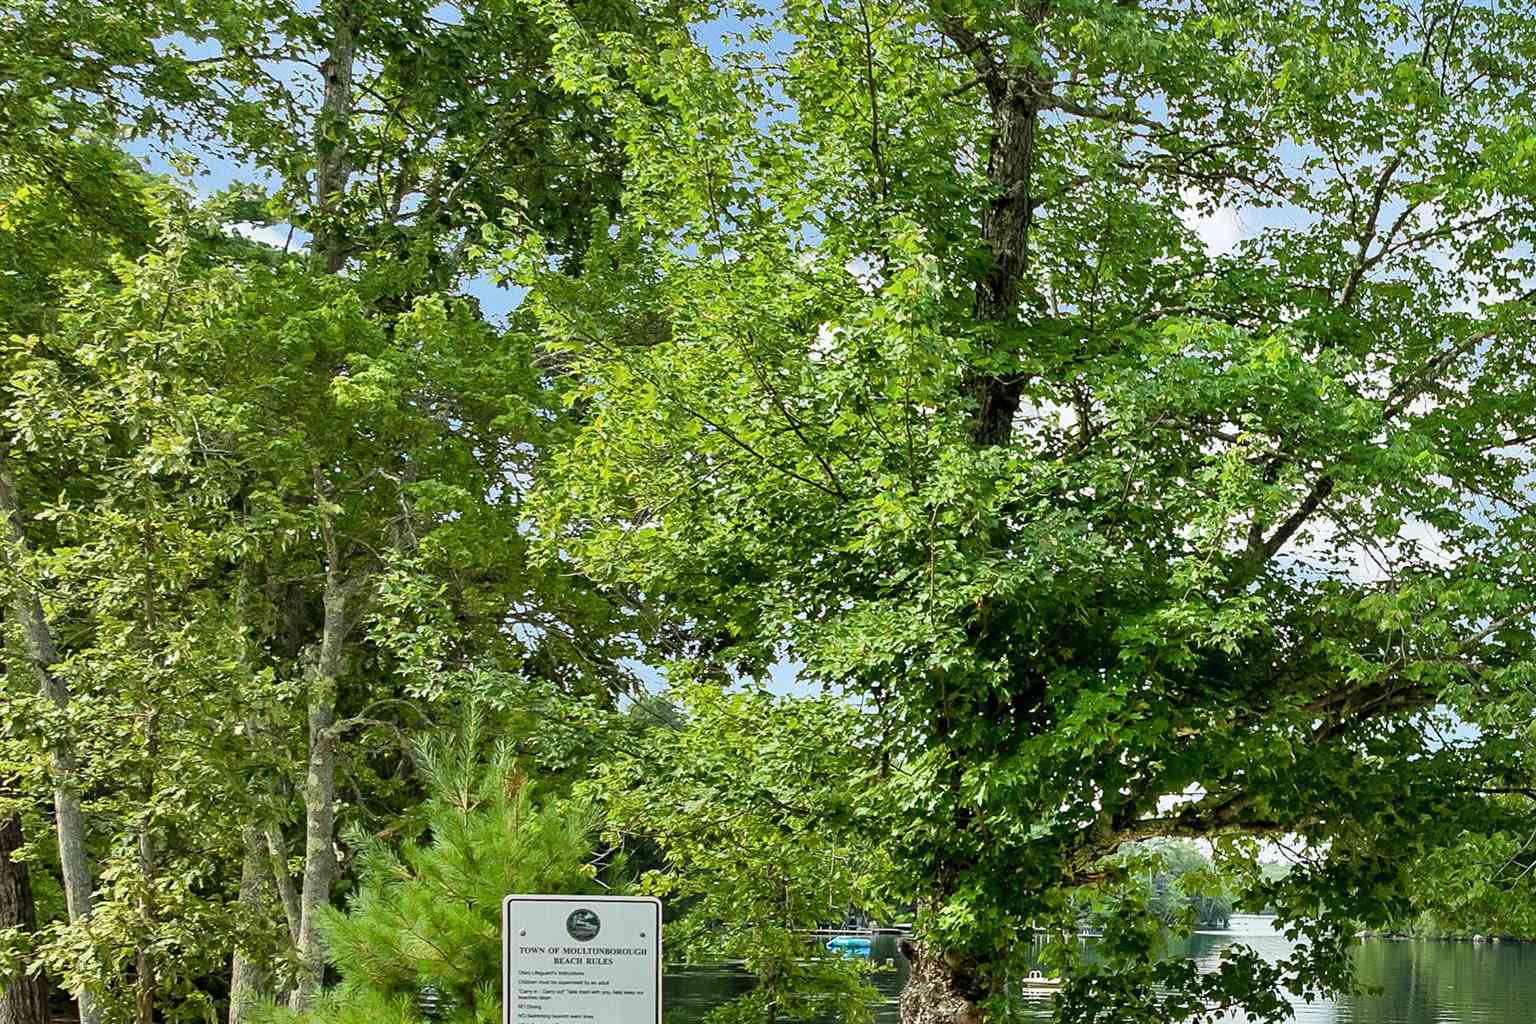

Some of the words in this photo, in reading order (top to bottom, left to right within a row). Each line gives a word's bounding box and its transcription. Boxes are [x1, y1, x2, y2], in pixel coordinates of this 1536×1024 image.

[520, 947, 545, 955] TOWN
[548, 947, 560, 955] OF
[562, 947, 647, 956] MOULTONBOROUGH
[586, 958, 614, 966] RULES
